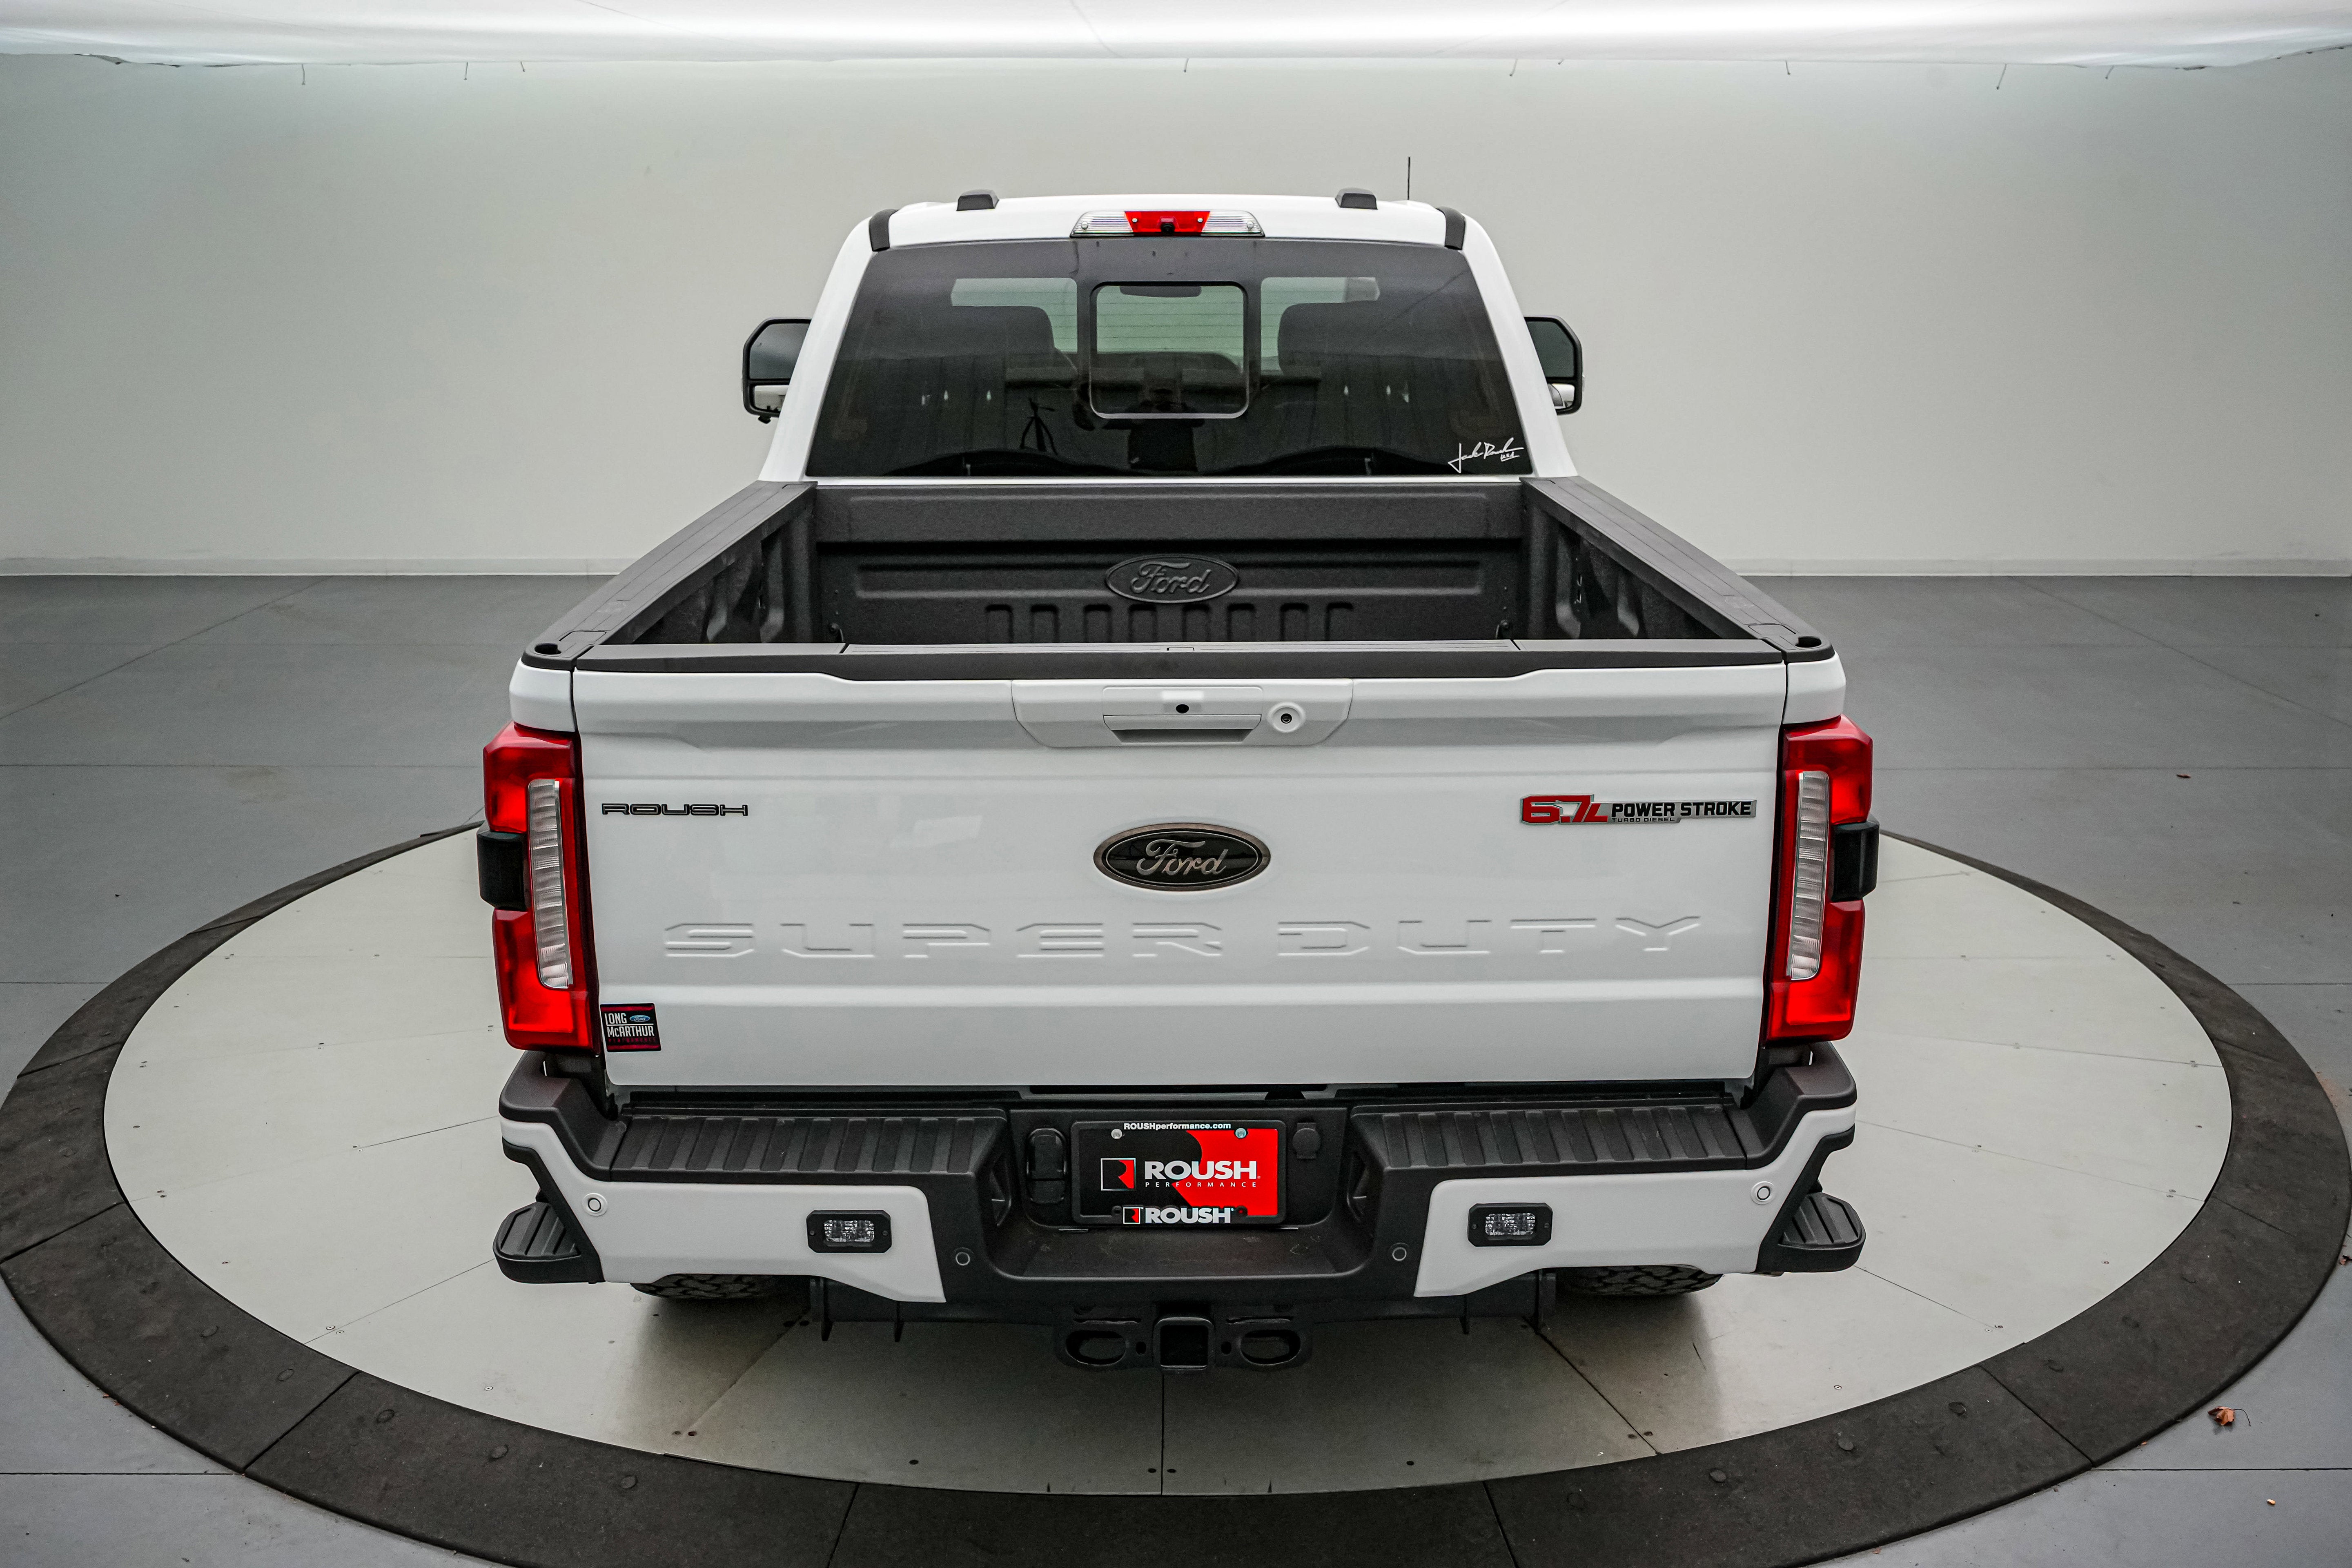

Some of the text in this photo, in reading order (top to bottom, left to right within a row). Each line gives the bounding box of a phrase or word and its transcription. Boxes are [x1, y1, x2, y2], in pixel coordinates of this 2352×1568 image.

[1130, 560, 1212, 594] Ford
[601, 803, 748, 816] ROUSH
[1612, 803, 1675, 817] POWER
[1680, 801, 1751, 816] STROKE
[1136, 839, 1228, 876] Ford
[664, 915, 1700, 958] SUPER DUTY
[604, 1013, 627, 1025] LONG
[607, 1025, 655, 1037] McARTHUR
[1124, 1123, 1231, 1131] ROUSHperformance.com
[1144, 1160, 1257, 1180] ROUSH
[1145, 1207, 1231, 1224] ROUSH
